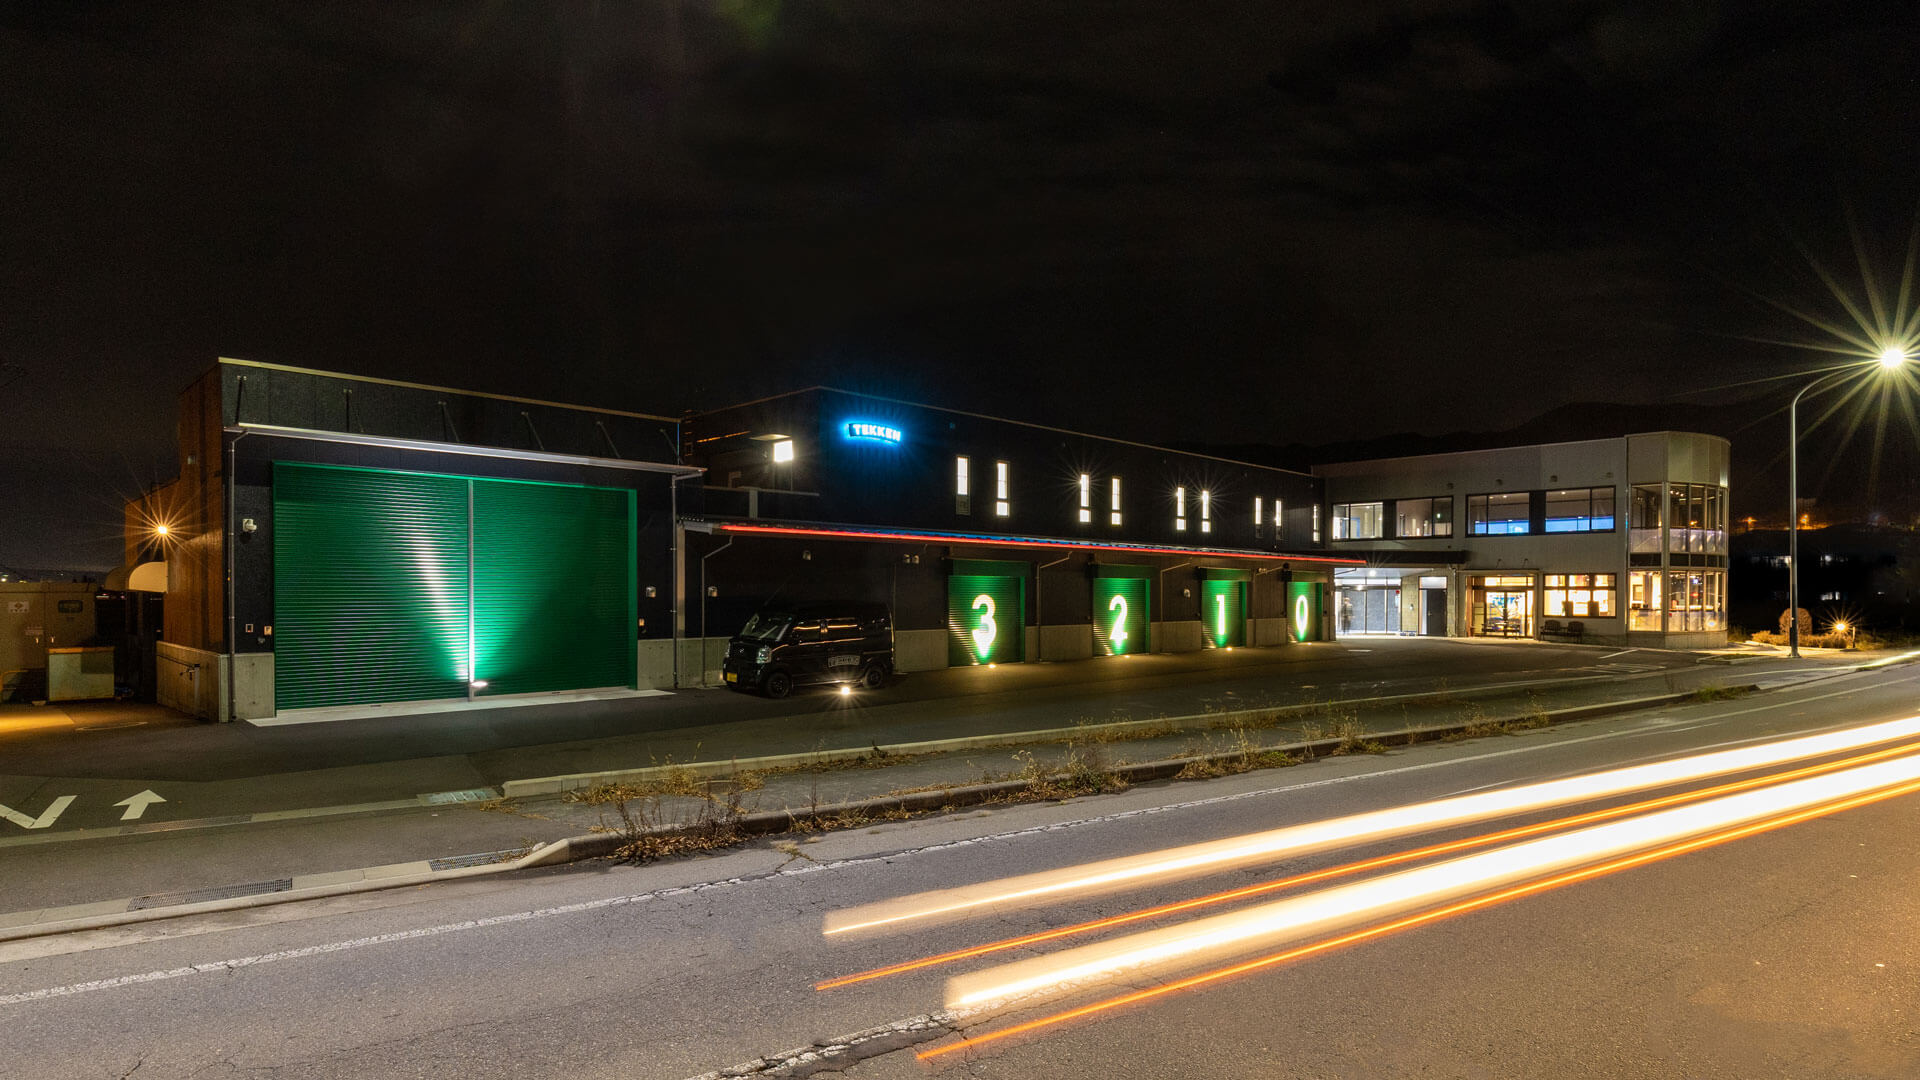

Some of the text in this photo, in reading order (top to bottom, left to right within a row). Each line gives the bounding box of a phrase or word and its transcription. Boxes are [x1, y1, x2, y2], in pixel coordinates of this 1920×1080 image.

[853, 424, 901, 442] TEKKEN
[972, 595, 997, 652] 3
[1109, 595, 1128, 641] 2
[1216, 595, 1226, 635] 1
[1295, 595, 1308, 635] 0
